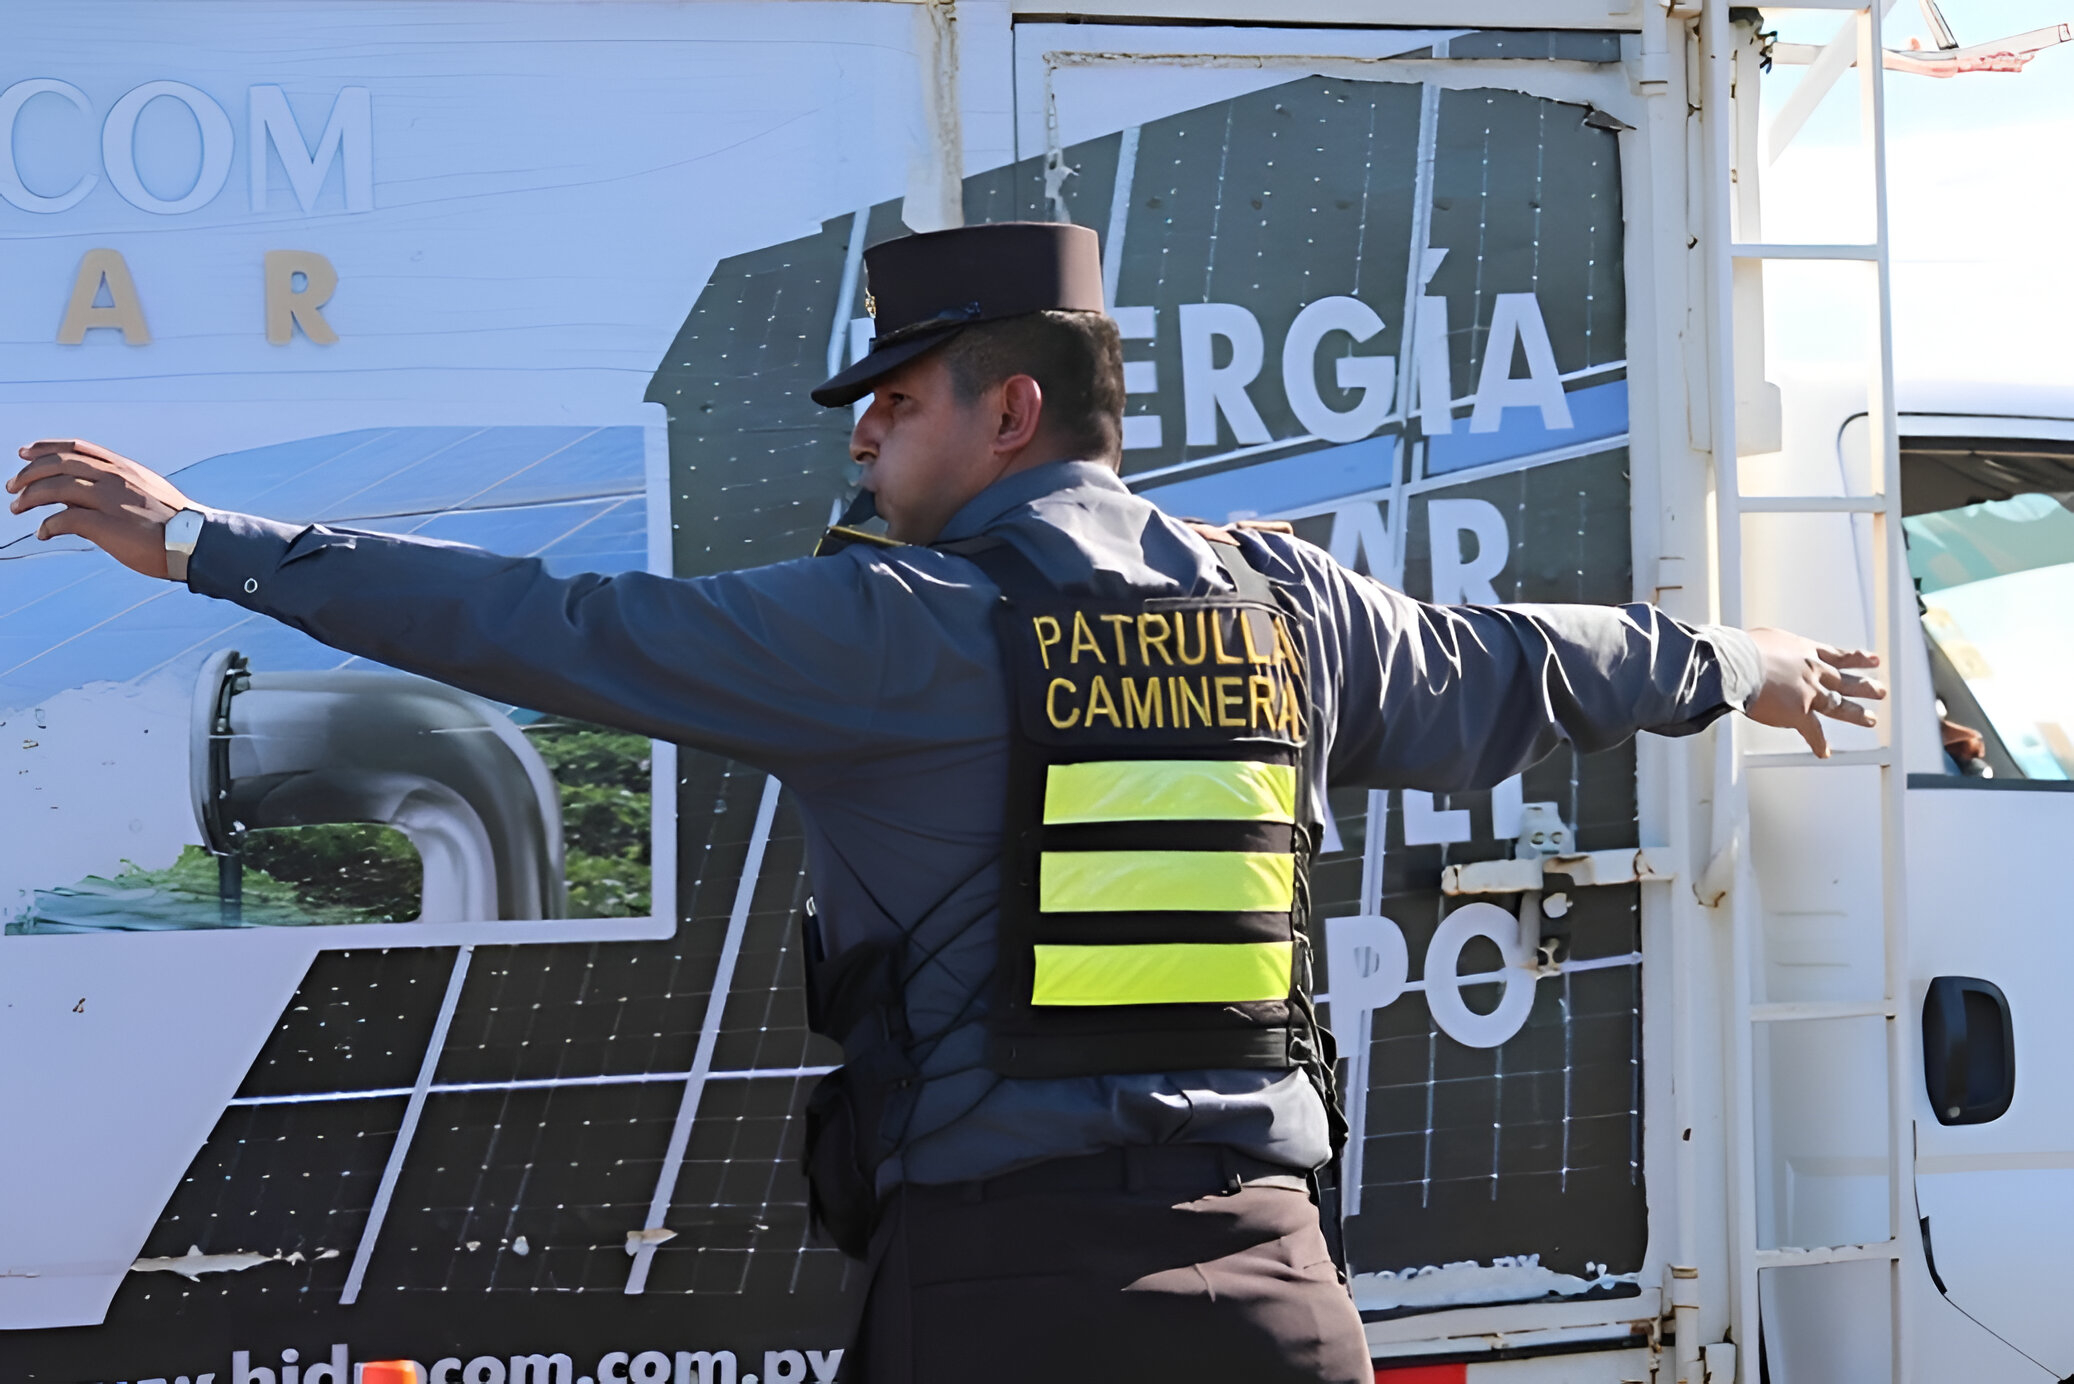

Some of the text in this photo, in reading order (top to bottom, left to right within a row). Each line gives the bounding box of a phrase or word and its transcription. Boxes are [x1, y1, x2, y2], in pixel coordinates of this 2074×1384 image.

[0, 77, 375, 215] COM
[850, 247, 1573, 450] ERGÍA
[1033, 610, 1303, 672] PATRULLA
[1046, 675, 1303, 742] CAMINERA
